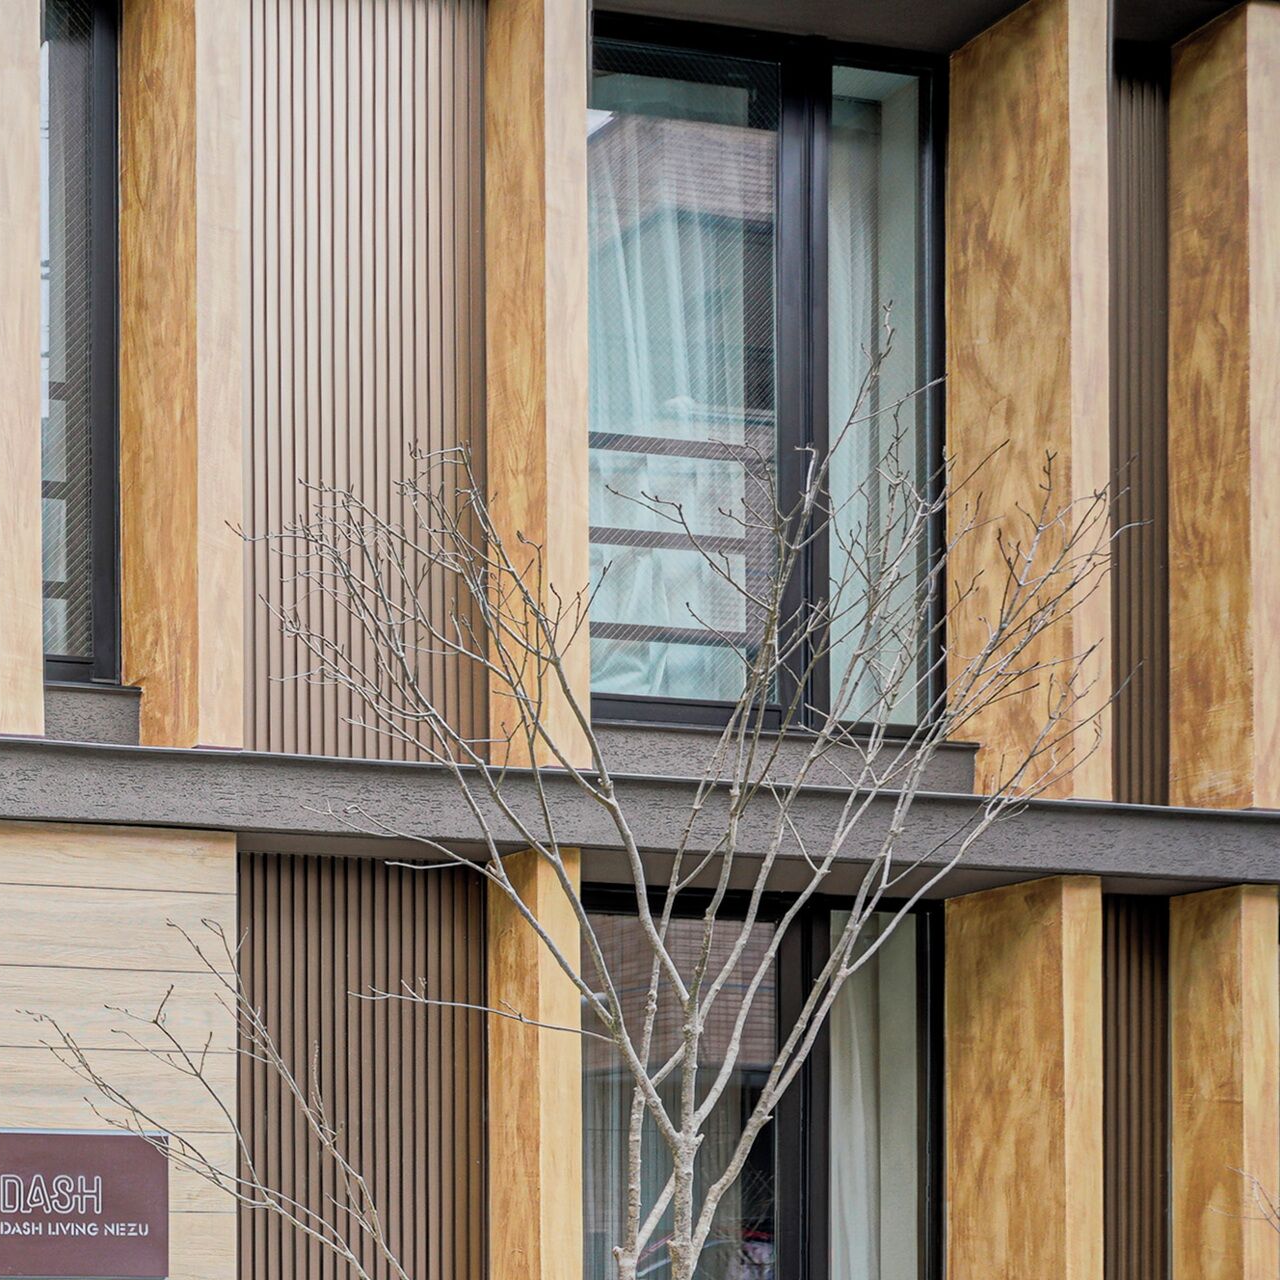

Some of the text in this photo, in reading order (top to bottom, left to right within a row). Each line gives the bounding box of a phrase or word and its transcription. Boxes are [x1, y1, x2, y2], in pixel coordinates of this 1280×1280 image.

[0, 1174, 101, 1214] DASH
[0, 1221, 149, 1236] DASH LIVING NEZU
